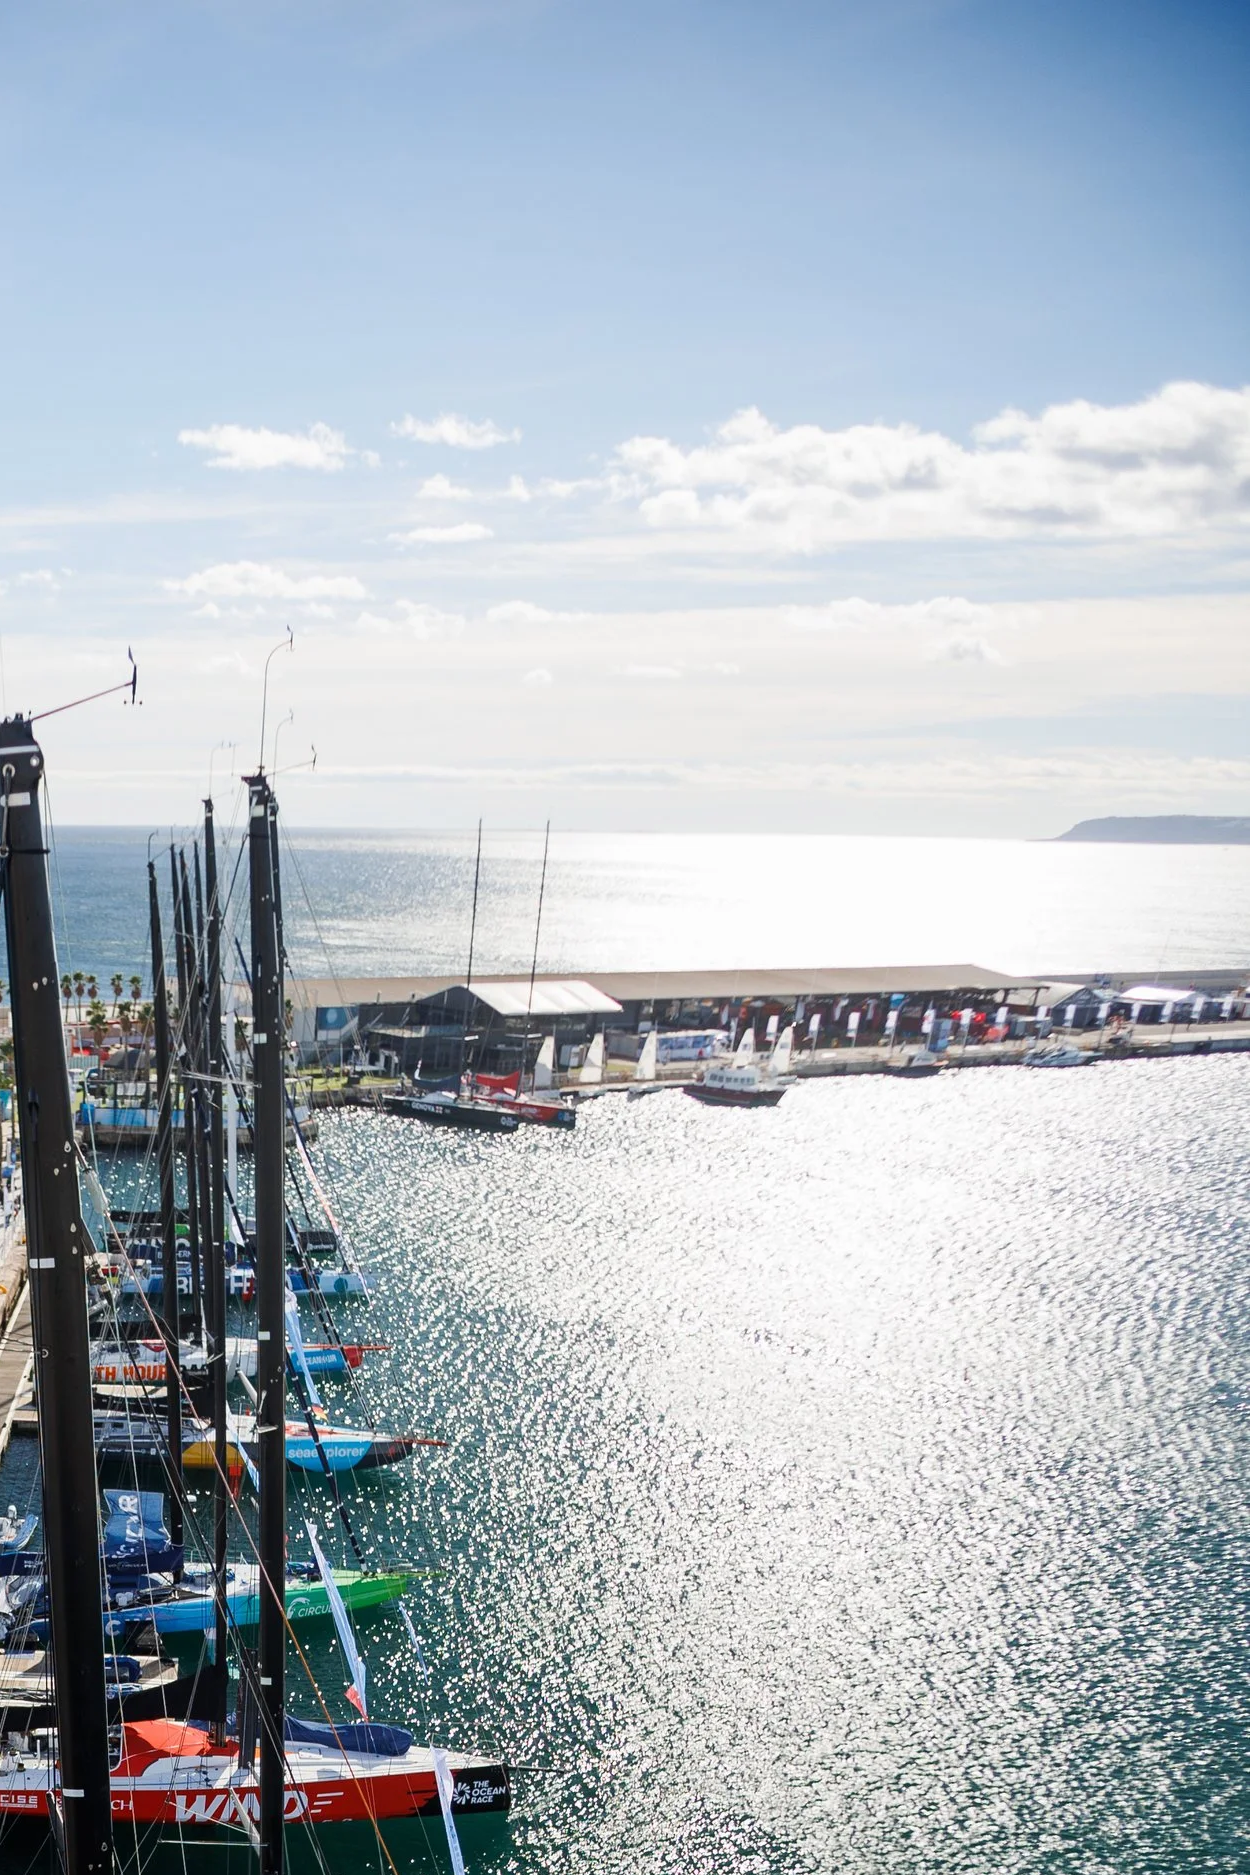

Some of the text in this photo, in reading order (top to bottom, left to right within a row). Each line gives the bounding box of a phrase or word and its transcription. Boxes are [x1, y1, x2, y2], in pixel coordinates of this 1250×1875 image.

[287, 1446, 365, 1461] seaeplorer
[297, 1603, 348, 1617] CIRCULR
[473, 1779, 490, 1789] THE
[471, 1786, 506, 1797] OCEAN
[470, 1795, 495, 1805] RACE
